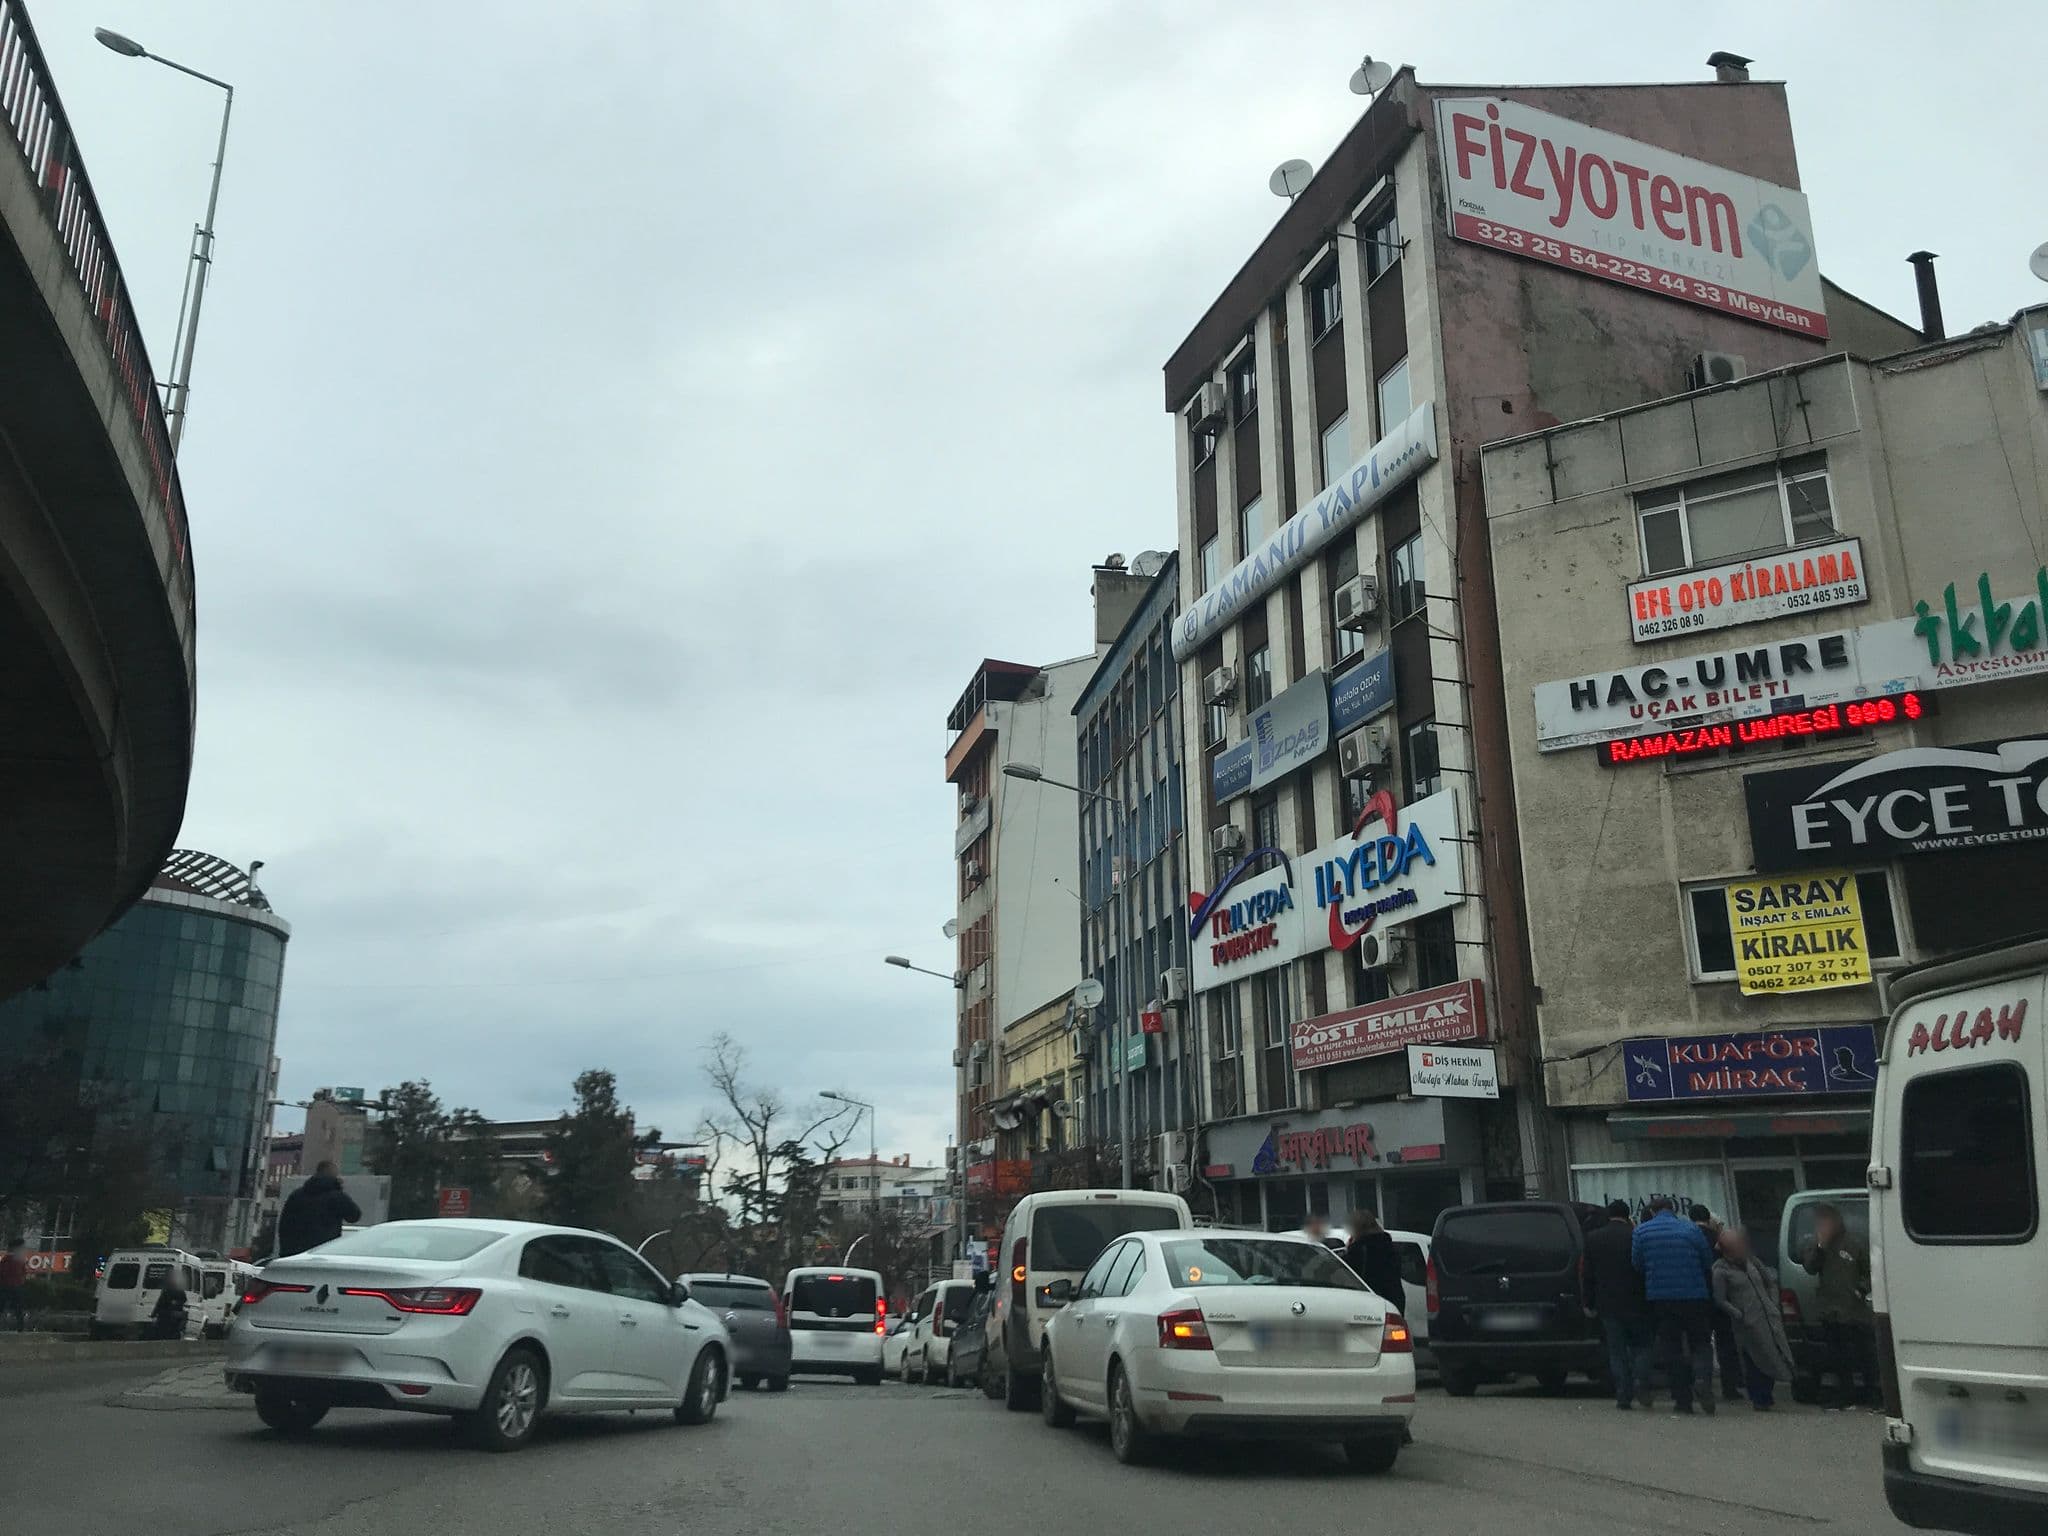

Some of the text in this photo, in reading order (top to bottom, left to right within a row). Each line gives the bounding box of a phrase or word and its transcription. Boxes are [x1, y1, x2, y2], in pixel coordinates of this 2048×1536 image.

[1477, 222, 1812, 328] 323 25 54-223 44 33 Meydan
[1634, 551, 1858, 620] EFE OTO KİRALAMA
[1638, 621, 1660, 636] 0462
[1661, 618, 1678, 632] 326
[1680, 616, 1691, 628] 08
[1693, 613, 1704, 626] 90
[1787, 593, 1811, 609] 0532
[1812, 588, 1831, 604] 485
[1833, 586, 1845, 600] 39
[1847, 583, 1860, 597] 59
[1630, 695, 1698, 719] UÇAK
[1610, 725, 1732, 762] RAMAZAN
[1791, 784, 1973, 850] EYCE
[1734, 876, 1849, 914] SARAY
[1740, 904, 1851, 927] İNŞAAT & EMLAK
[1741, 927, 1858, 961] KİRALIK
[1747, 957, 1858, 977] 0507 307 37 37
[1749, 977, 1785, 990] 0462
[1788, 974, 1816, 986] 224
[1820, 972, 1838, 982] 40
[1294, 999, 1468, 1049] DOST EMLAK
[1908, 999, 2029, 1058] ALLAH
[1435, 1056, 1482, 1067] DİŞ HEKİMİ
[1670, 1034, 1821, 1065] KUAFÖR
[1688, 1066, 1808, 1092] MİRAÇ
